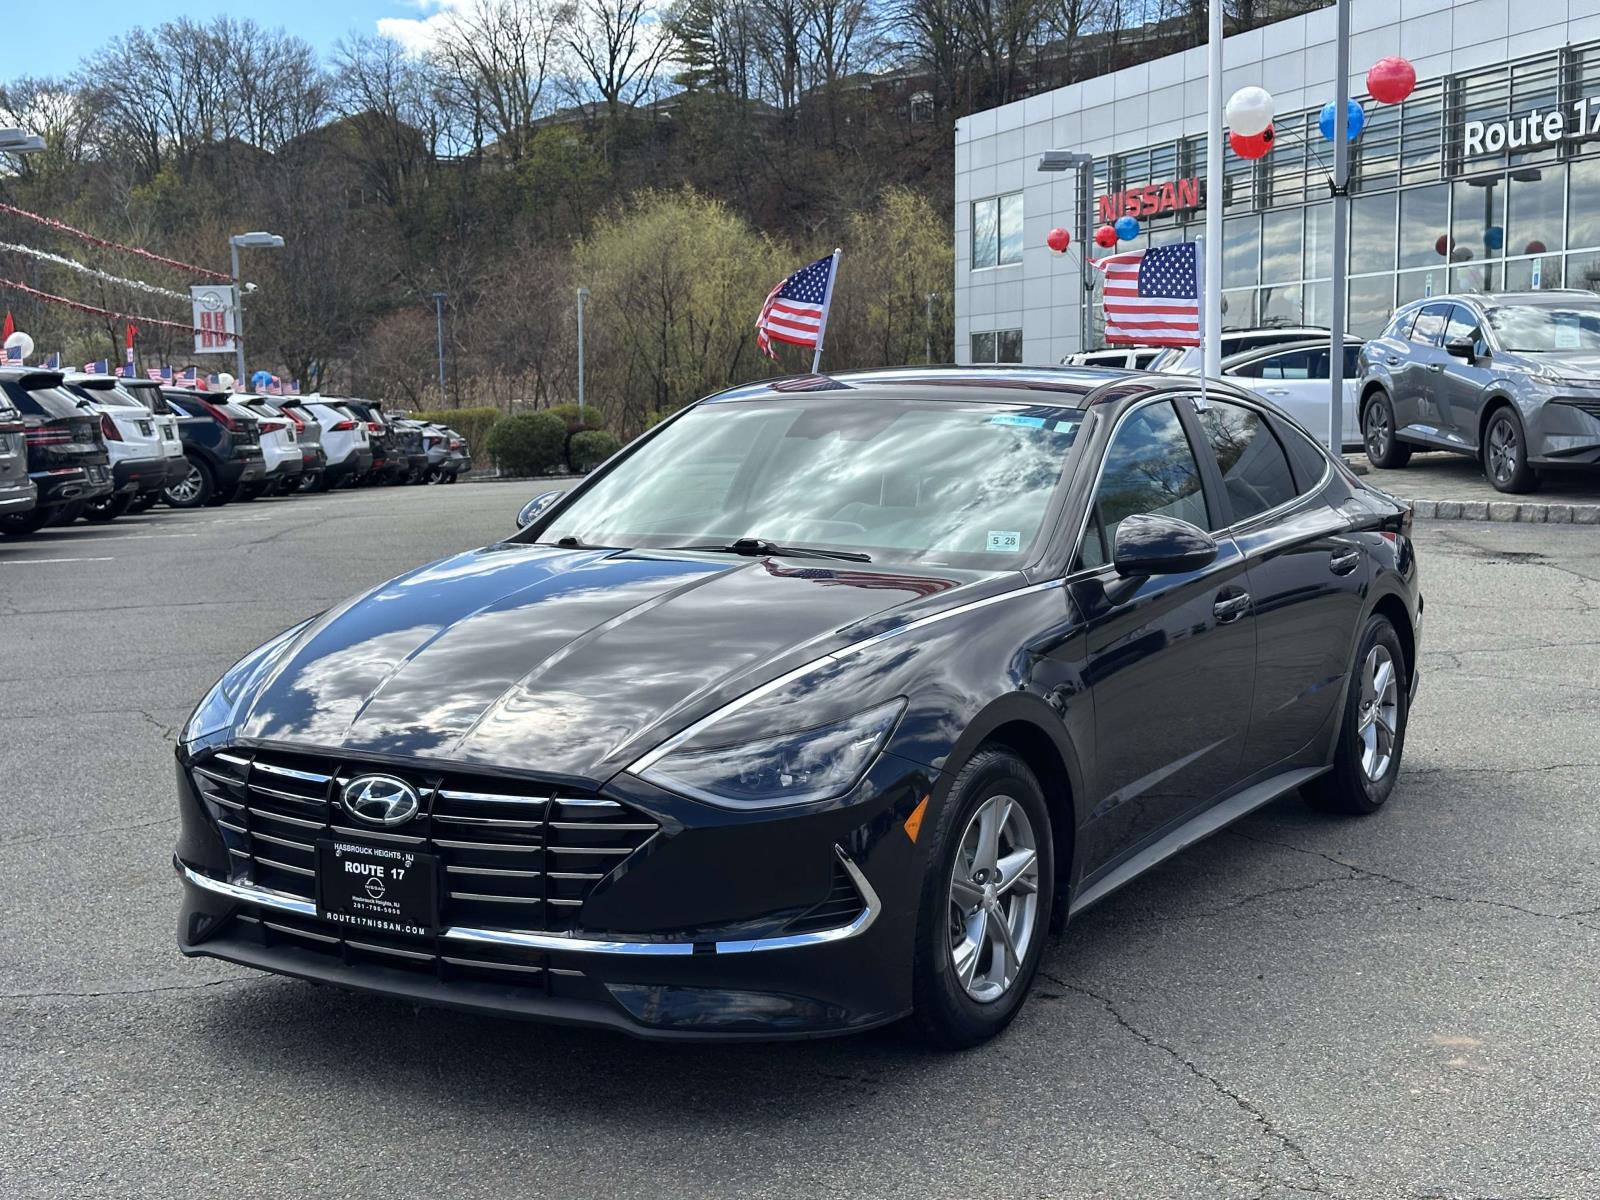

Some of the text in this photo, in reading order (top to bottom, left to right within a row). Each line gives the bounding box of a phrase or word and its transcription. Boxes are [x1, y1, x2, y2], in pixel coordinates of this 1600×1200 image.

[1464, 109, 1564, 155] Route
[1099, 176, 1199, 223] NISSAN
[1004, 536, 1016, 546] 28
[334, 843, 373, 855] HASBROUCK
[405, 853, 414, 862] NJ
[345, 861, 405, 880] ROUTE 17
[326, 912, 425, 935] ROUTE17NISSAN.COM
